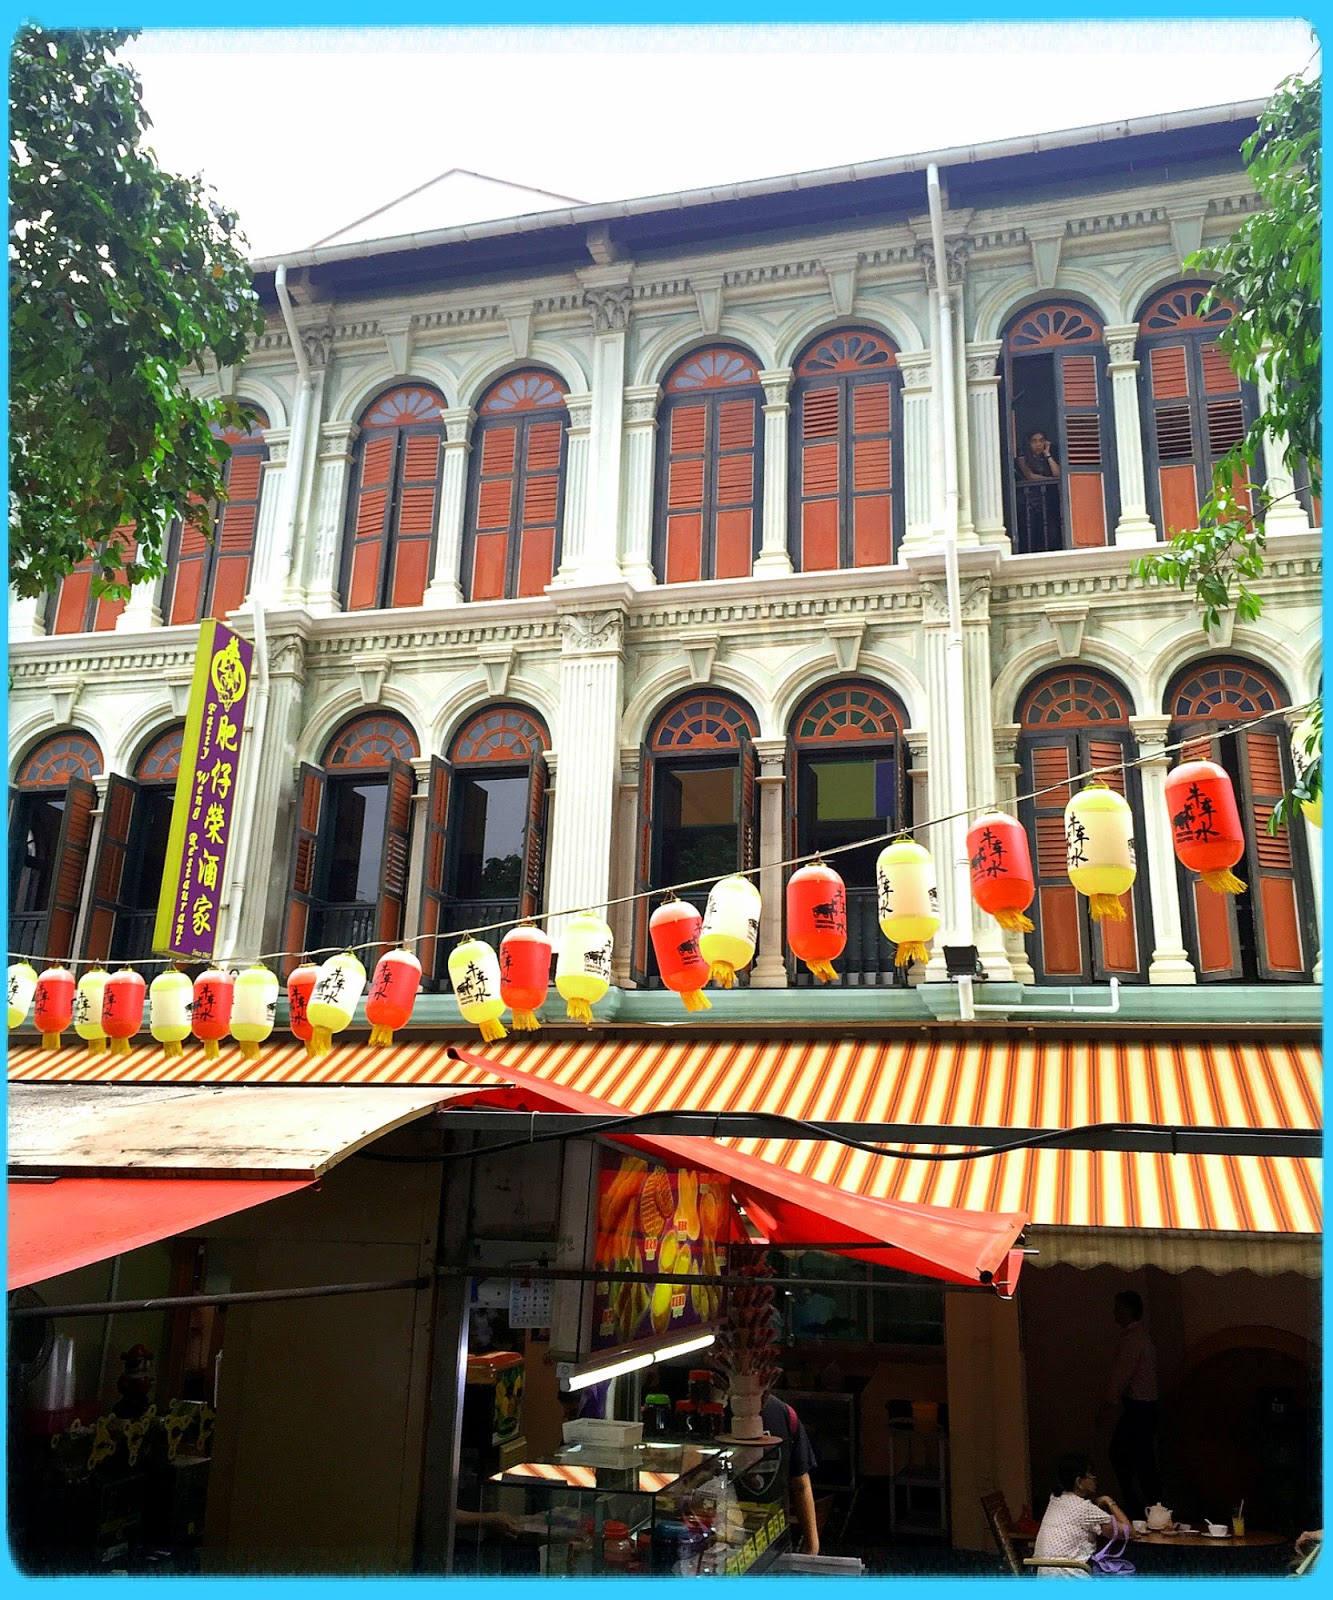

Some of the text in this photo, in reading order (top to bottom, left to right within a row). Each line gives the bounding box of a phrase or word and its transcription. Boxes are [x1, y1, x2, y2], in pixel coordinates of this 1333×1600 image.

[174, 702, 217, 946] Fatty Weng Restaurant
